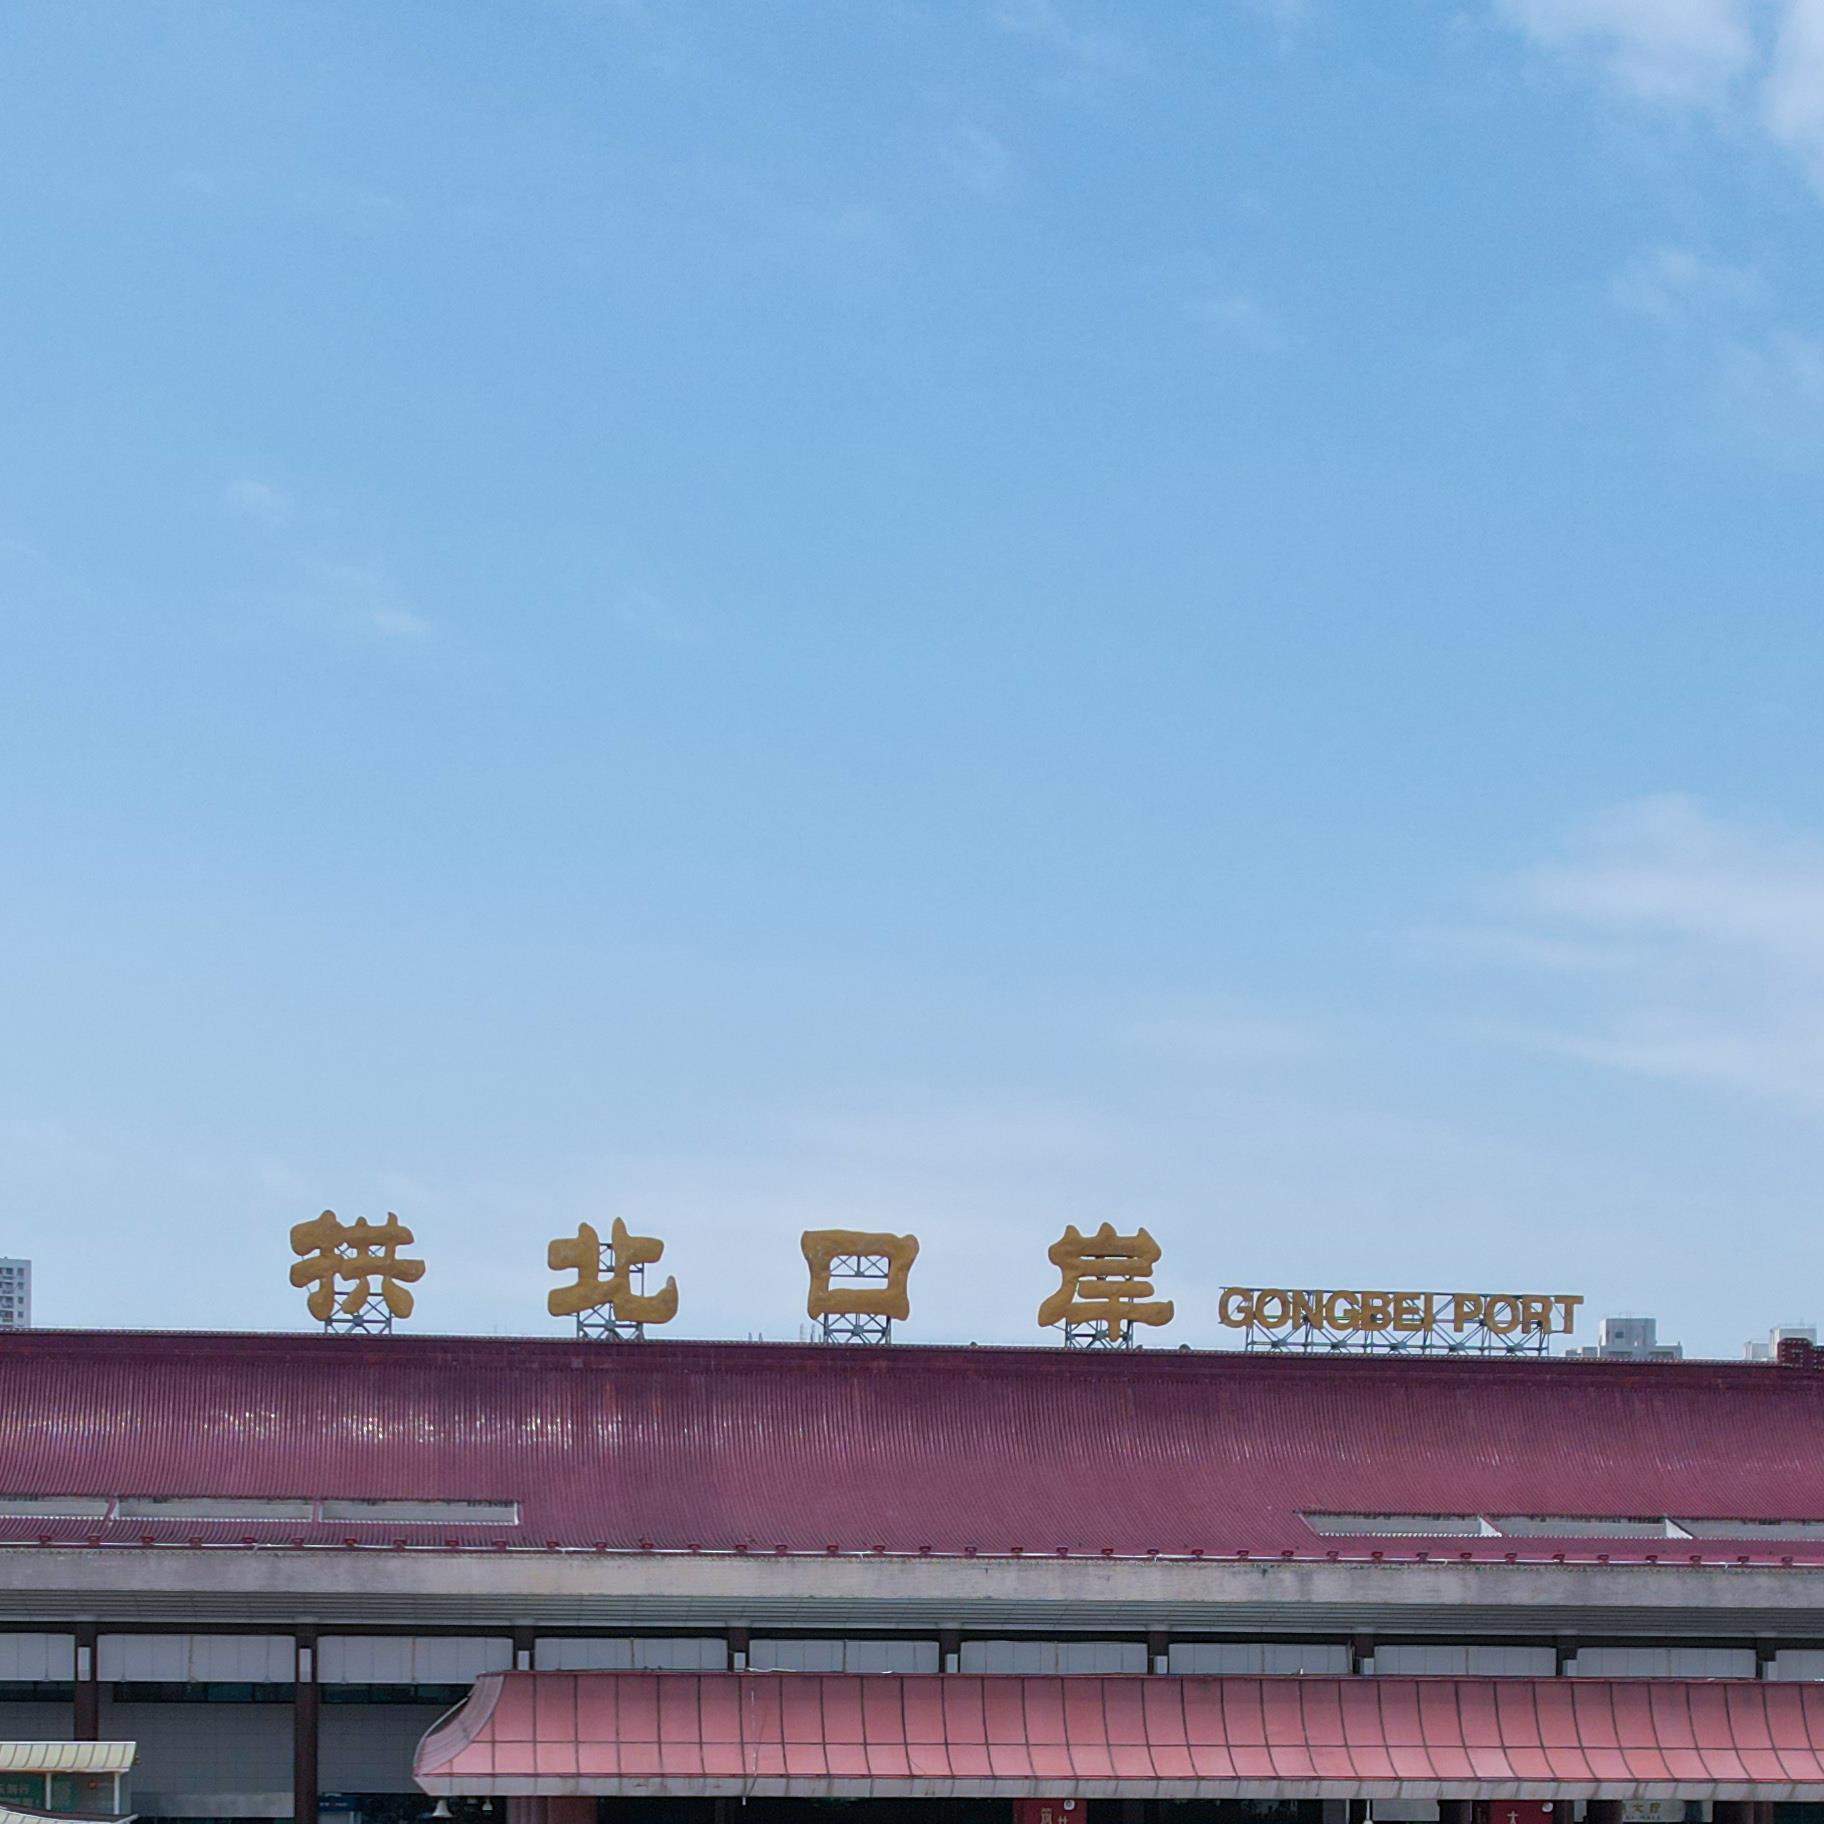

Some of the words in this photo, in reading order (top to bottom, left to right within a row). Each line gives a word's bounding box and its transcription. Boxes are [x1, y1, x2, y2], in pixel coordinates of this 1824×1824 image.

[289, 1209, 1175, 1343] 拱北口岸
[1218, 1287, 1434, 1332] GONGBEI
[1454, 1294, 1585, 1335] PORT
